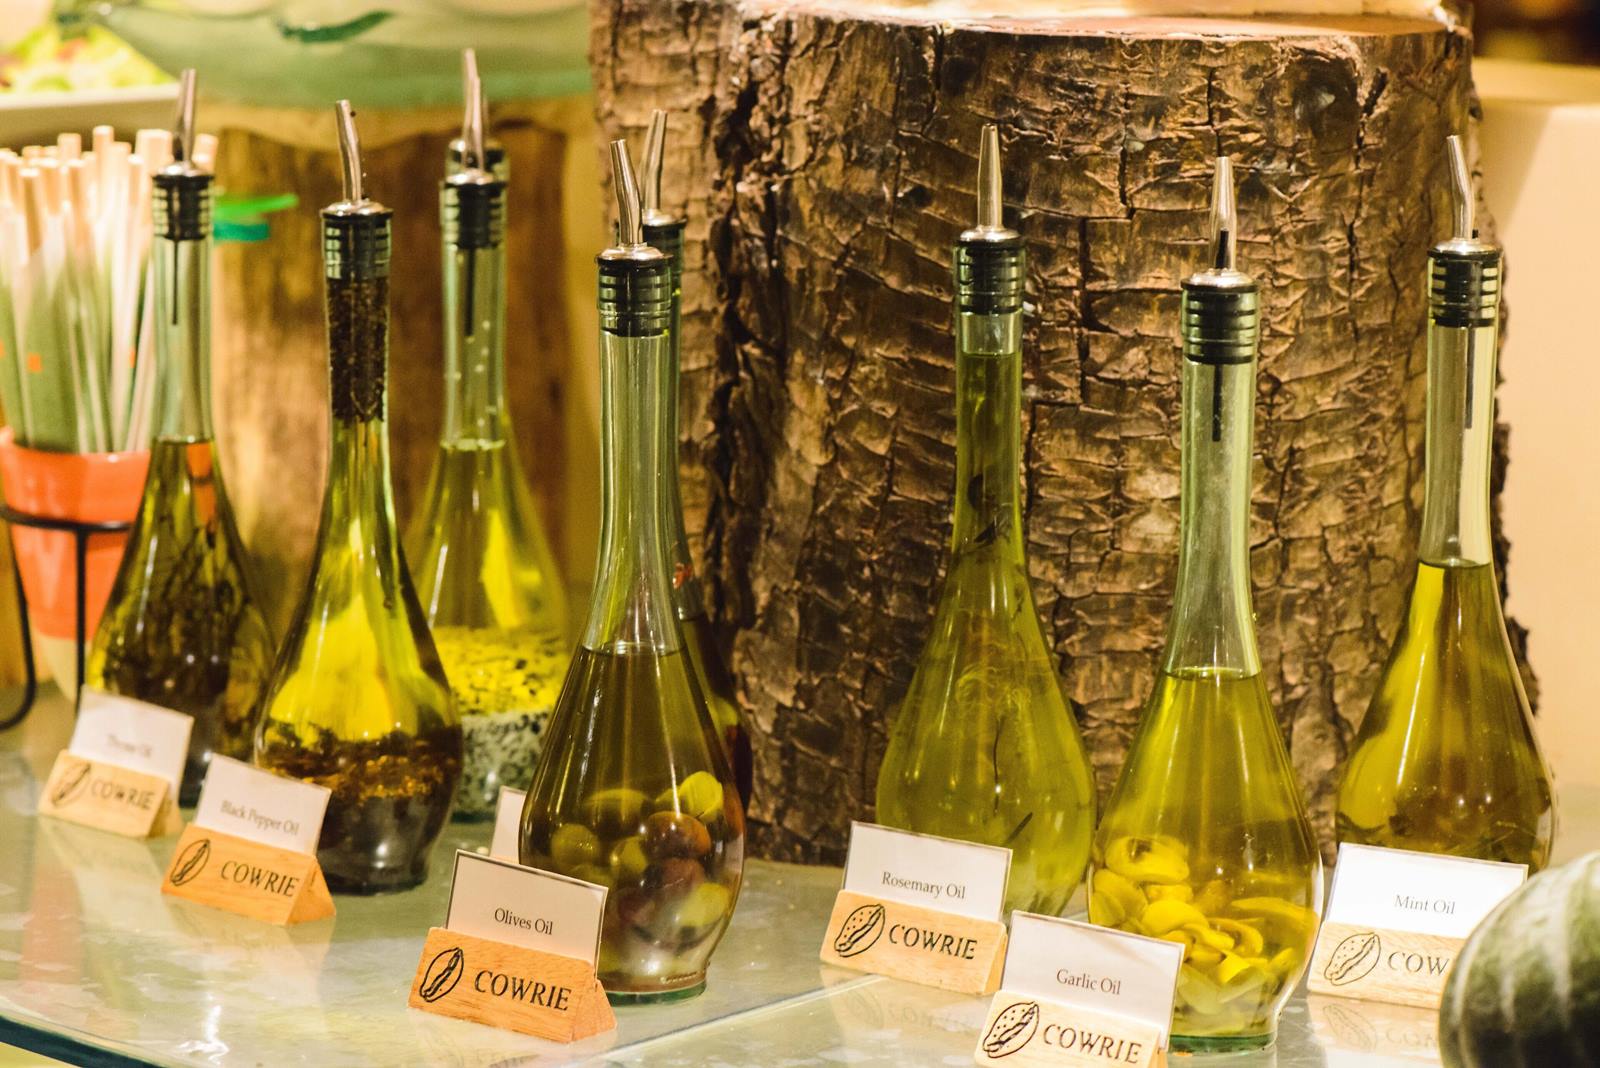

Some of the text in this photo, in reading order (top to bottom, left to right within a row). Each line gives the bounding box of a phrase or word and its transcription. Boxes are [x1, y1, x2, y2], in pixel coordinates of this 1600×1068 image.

[91, 778, 155, 811] COWRIE
[220, 799, 299, 835] Black Pepper Oil
[221, 860, 300, 897] COWRIE
[882, 871, 966, 899] Rosemary Oil
[1394, 894, 1456, 914] Mint Oil
[494, 907, 553, 936] Olives Oil
[889, 923, 978, 960] COWRIE
[1387, 951, 1450, 976] COW
[474, 969, 573, 1012] COWRIE
[1056, 968, 1121, 996] Garlic Oil
[1043, 1023, 1142, 1065] COWRIE
